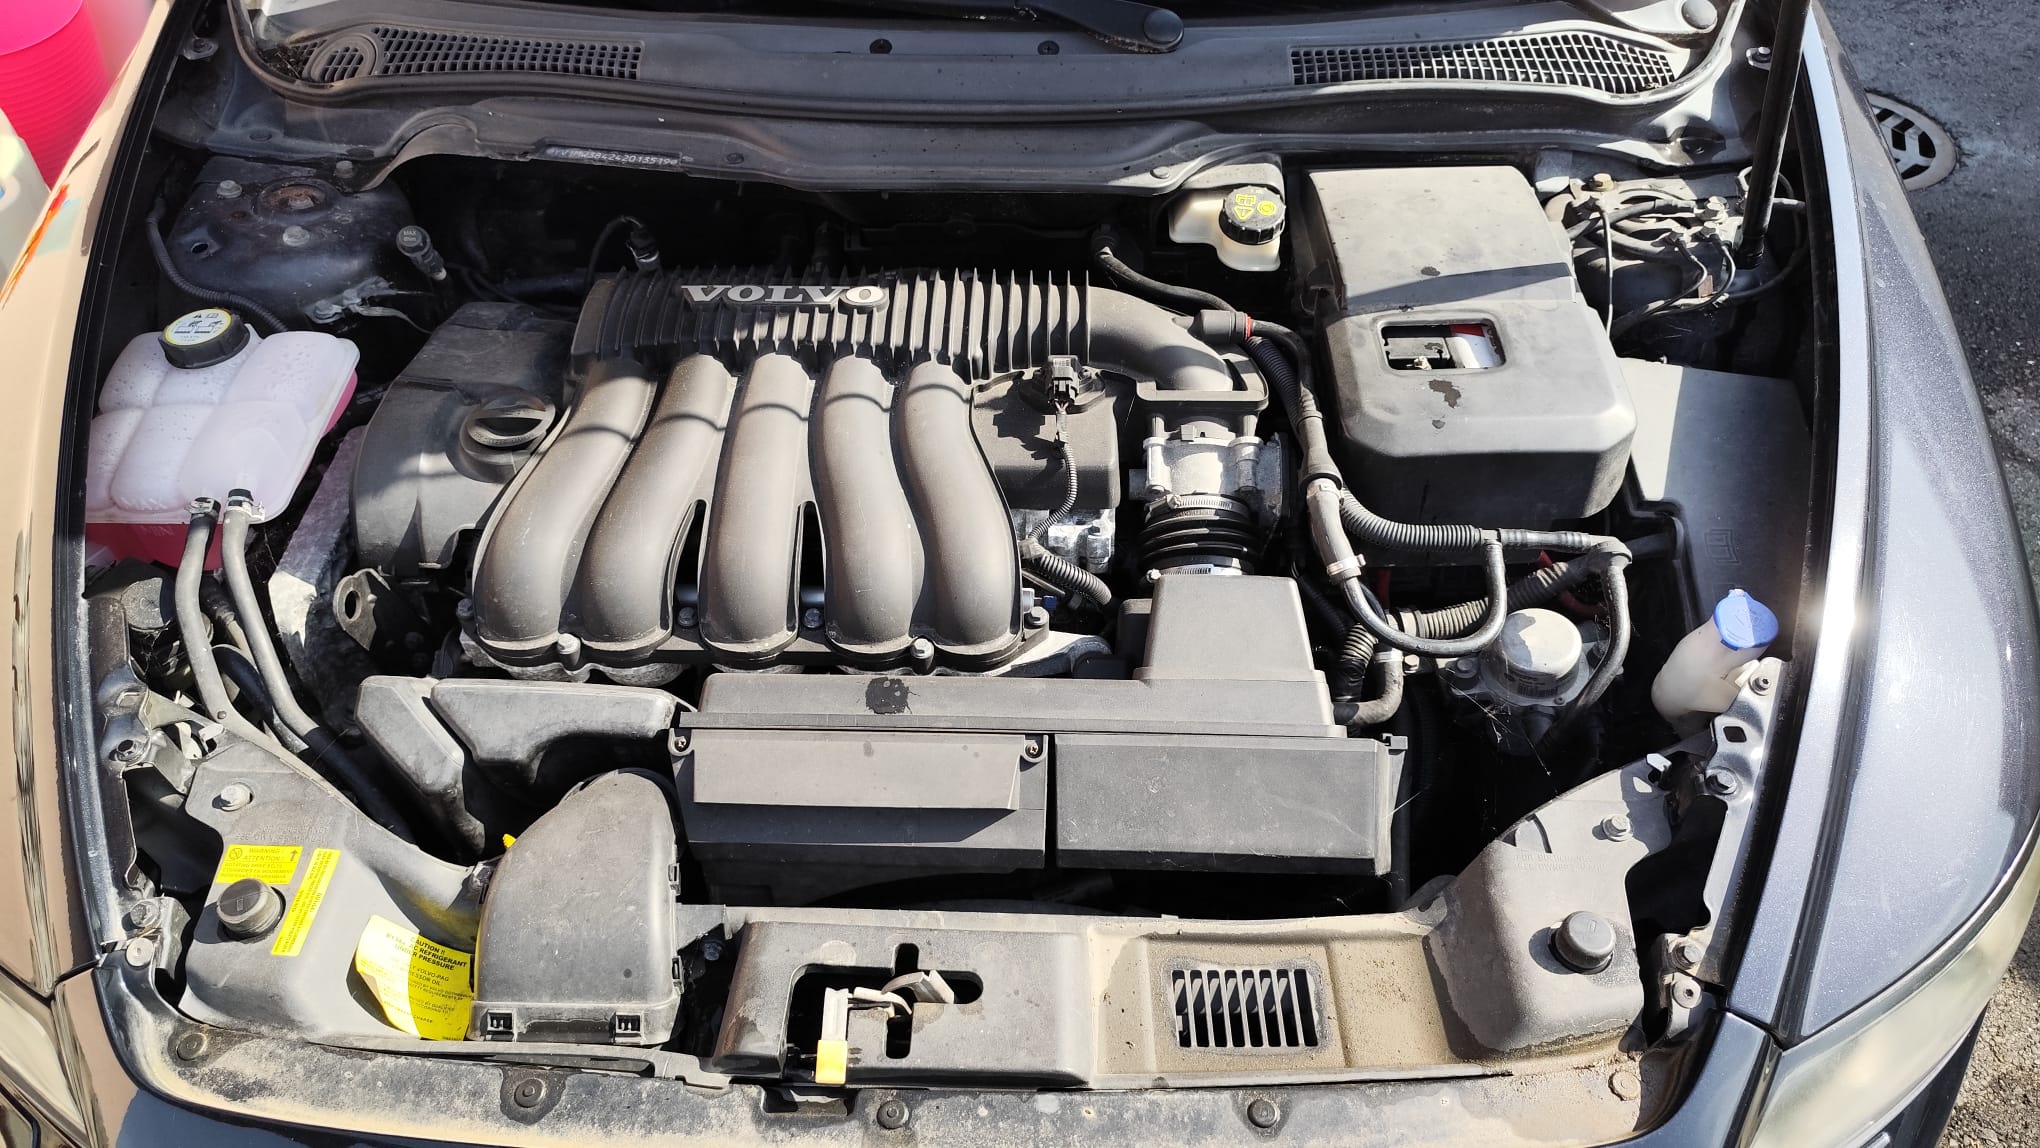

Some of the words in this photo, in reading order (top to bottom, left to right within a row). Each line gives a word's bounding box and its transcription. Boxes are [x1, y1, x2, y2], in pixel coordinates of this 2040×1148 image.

[681, 285, 887, 304] VOLVO
[410, 936, 440, 953] CAUTION
[418, 954, 456, 970] PRESSURE
[419, 947, 468, 967] REFRIGERANT
